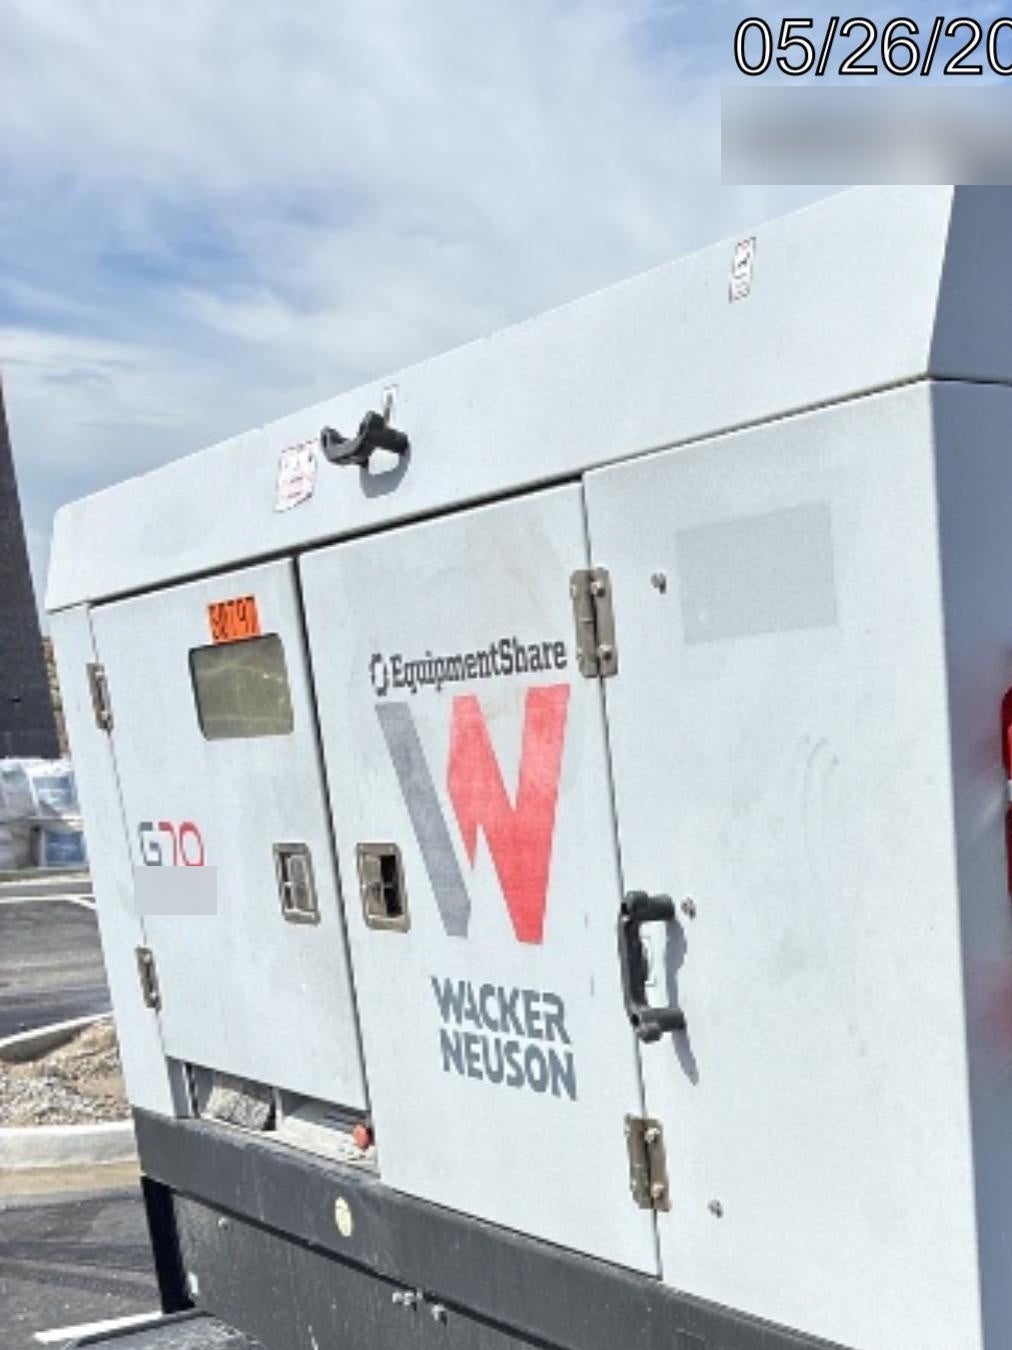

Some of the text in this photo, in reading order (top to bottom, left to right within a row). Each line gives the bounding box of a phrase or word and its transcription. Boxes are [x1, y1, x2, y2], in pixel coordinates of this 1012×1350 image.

[390, 635, 568, 694] EquipmentShare
[138, 821, 204, 866] G70
[430, 976, 571, 1044] WACKER
[440, 1027, 578, 1101] NEUSON
